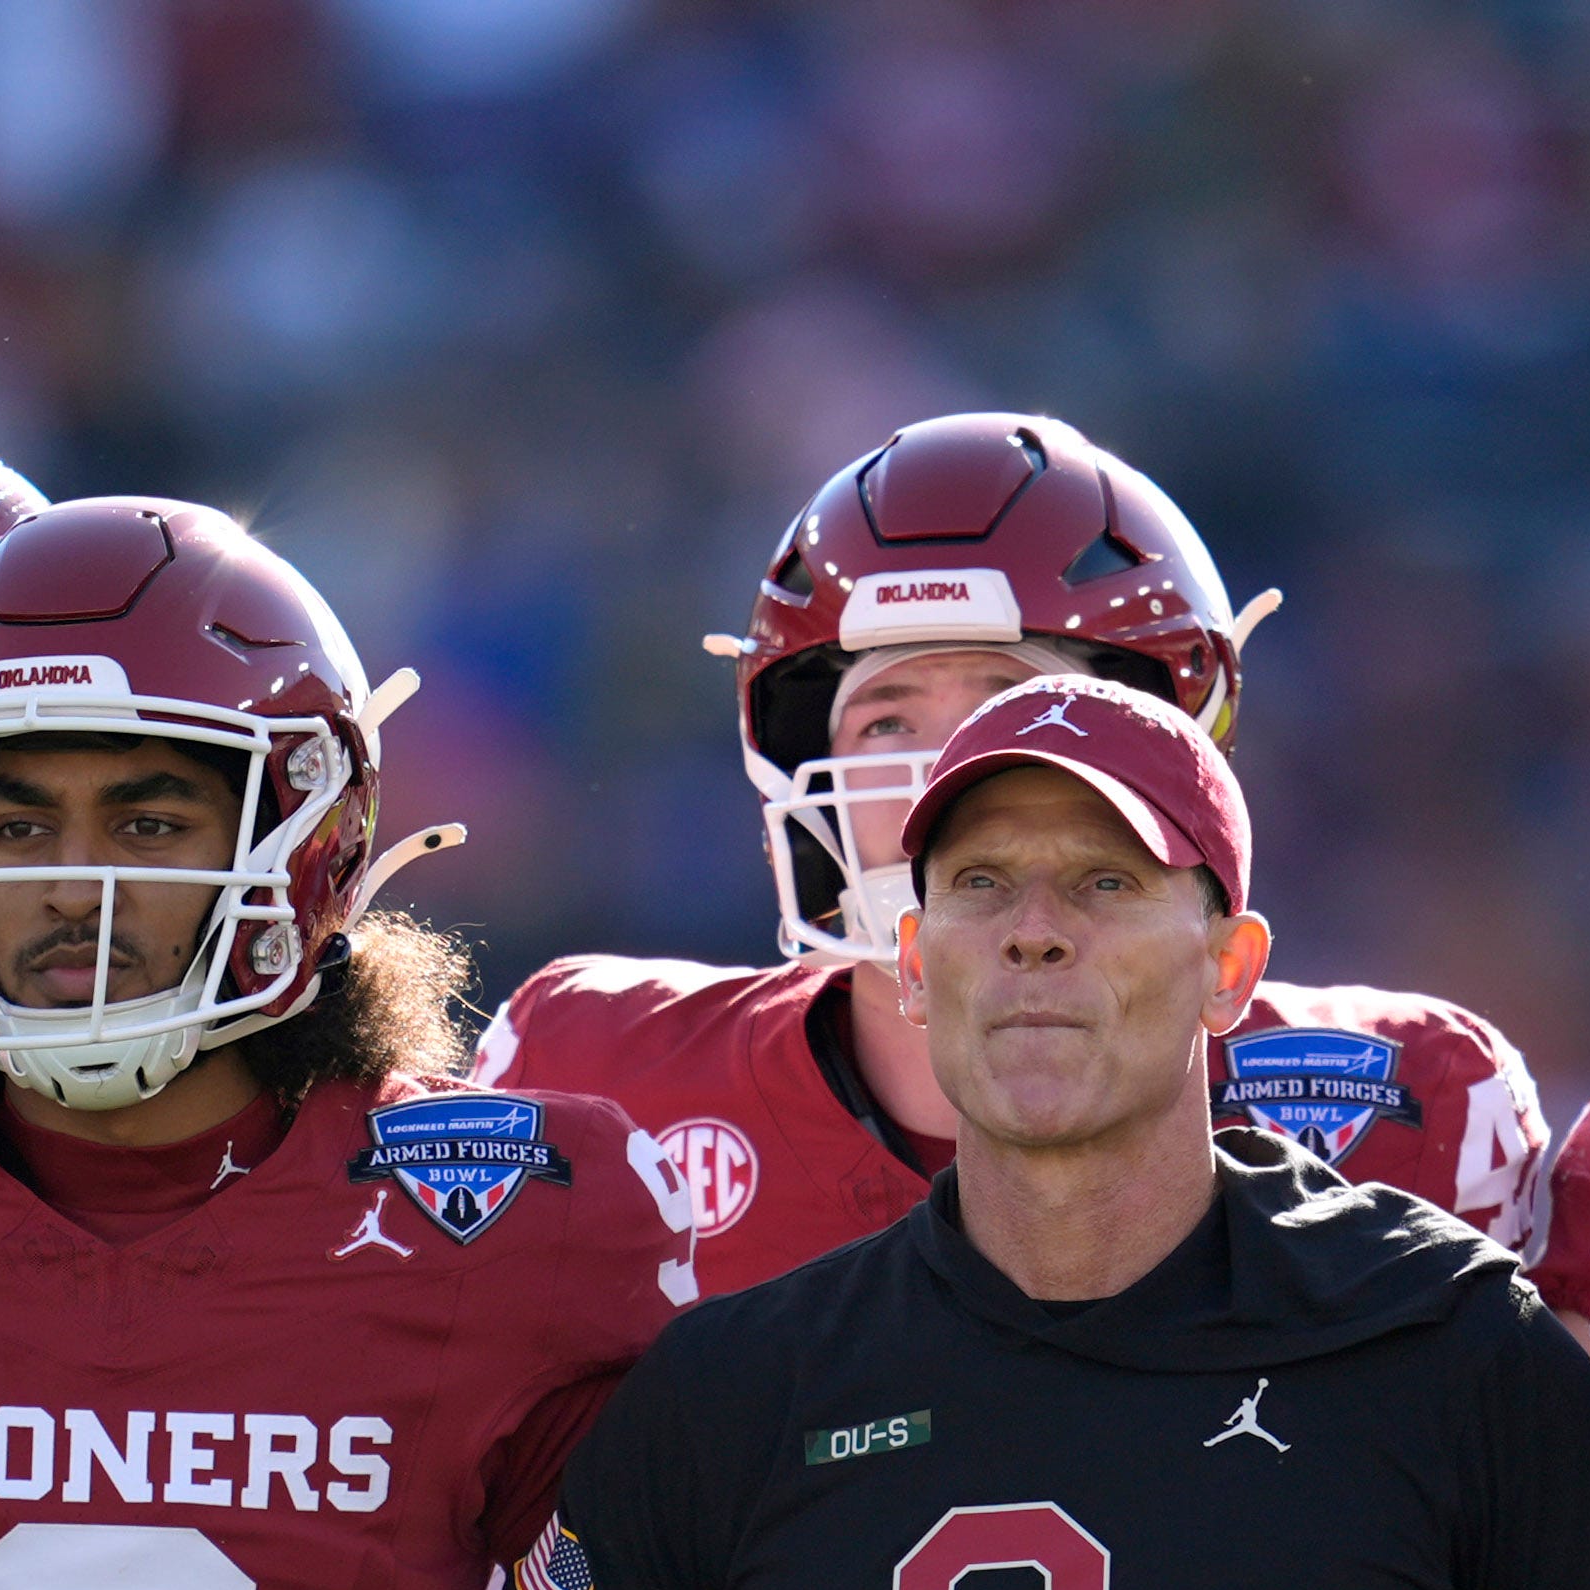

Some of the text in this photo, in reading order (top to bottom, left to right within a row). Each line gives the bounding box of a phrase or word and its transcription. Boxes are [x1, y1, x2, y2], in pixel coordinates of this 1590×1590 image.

[876, 582, 970, 605] OKLAHOMA
[1223, 1077, 1401, 1107] ARMED FORCES
[448, 1120, 494, 1130] MARTIN
[1280, 1106, 1343, 1122] BOWL
[369, 1140, 549, 1166] ARMED FORCES
[429, 1168, 492, 1183] BOWL
[831, 1417, 909, 1459] OU-S
